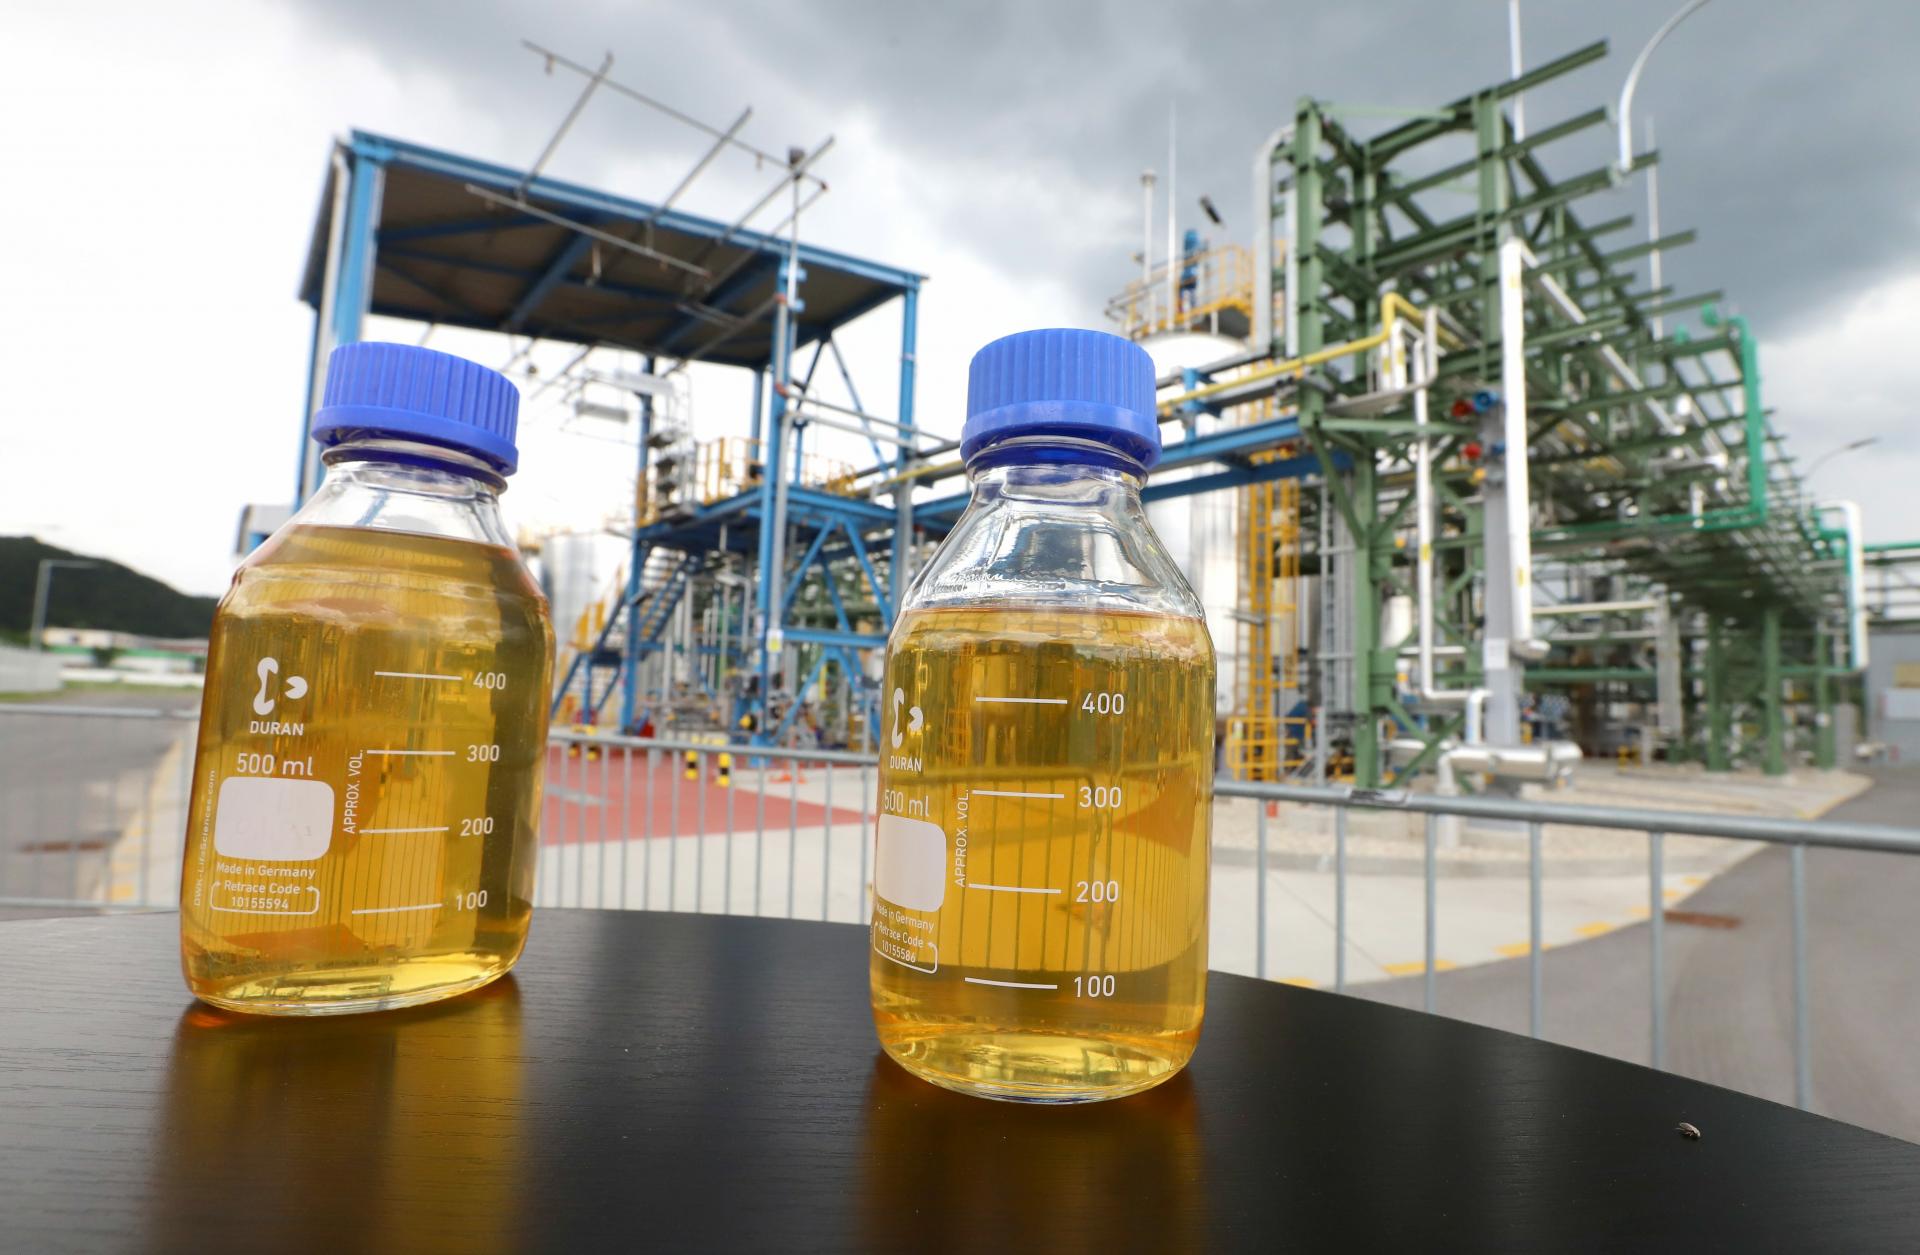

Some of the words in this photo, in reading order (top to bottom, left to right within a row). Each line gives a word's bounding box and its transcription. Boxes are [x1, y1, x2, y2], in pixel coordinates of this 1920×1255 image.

[473, 671, 507, 690] 400
[1081, 692, 1125, 715] 400
[250, 720, 304, 736] DURAN
[236, 752, 276, 775] 500
[282, 756, 313, 776] ml
[348, 749, 363, 777] VOL.
[466, 744, 500, 762] 300
[889, 755, 922, 772] DURAN
[343, 780, 361, 834] APPROX.
[884, 789, 904, 813] 500
[908, 795, 930, 817] ml
[957, 789, 969, 820] VOL.
[1078, 786, 1122, 808] 300
[460, 817, 494, 836] 200
[954, 825, 968, 888] APPROX.
[216, 862, 242, 875] Made
[244, 866, 255, 876] in
[257, 865, 316, 880] Germany
[224, 880, 266, 893] Retrace
[269, 882, 301, 895] Code
[1075, 881, 1119, 903] 200
[231, 896, 289, 910] 10155594
[455, 890, 488, 911] 100
[888, 910, 896, 920] in
[895, 910, 935, 934] Germany
[882, 940, 917, 963] 10155586
[902, 932, 924, 949] Code
[1073, 975, 1116, 998] 100
